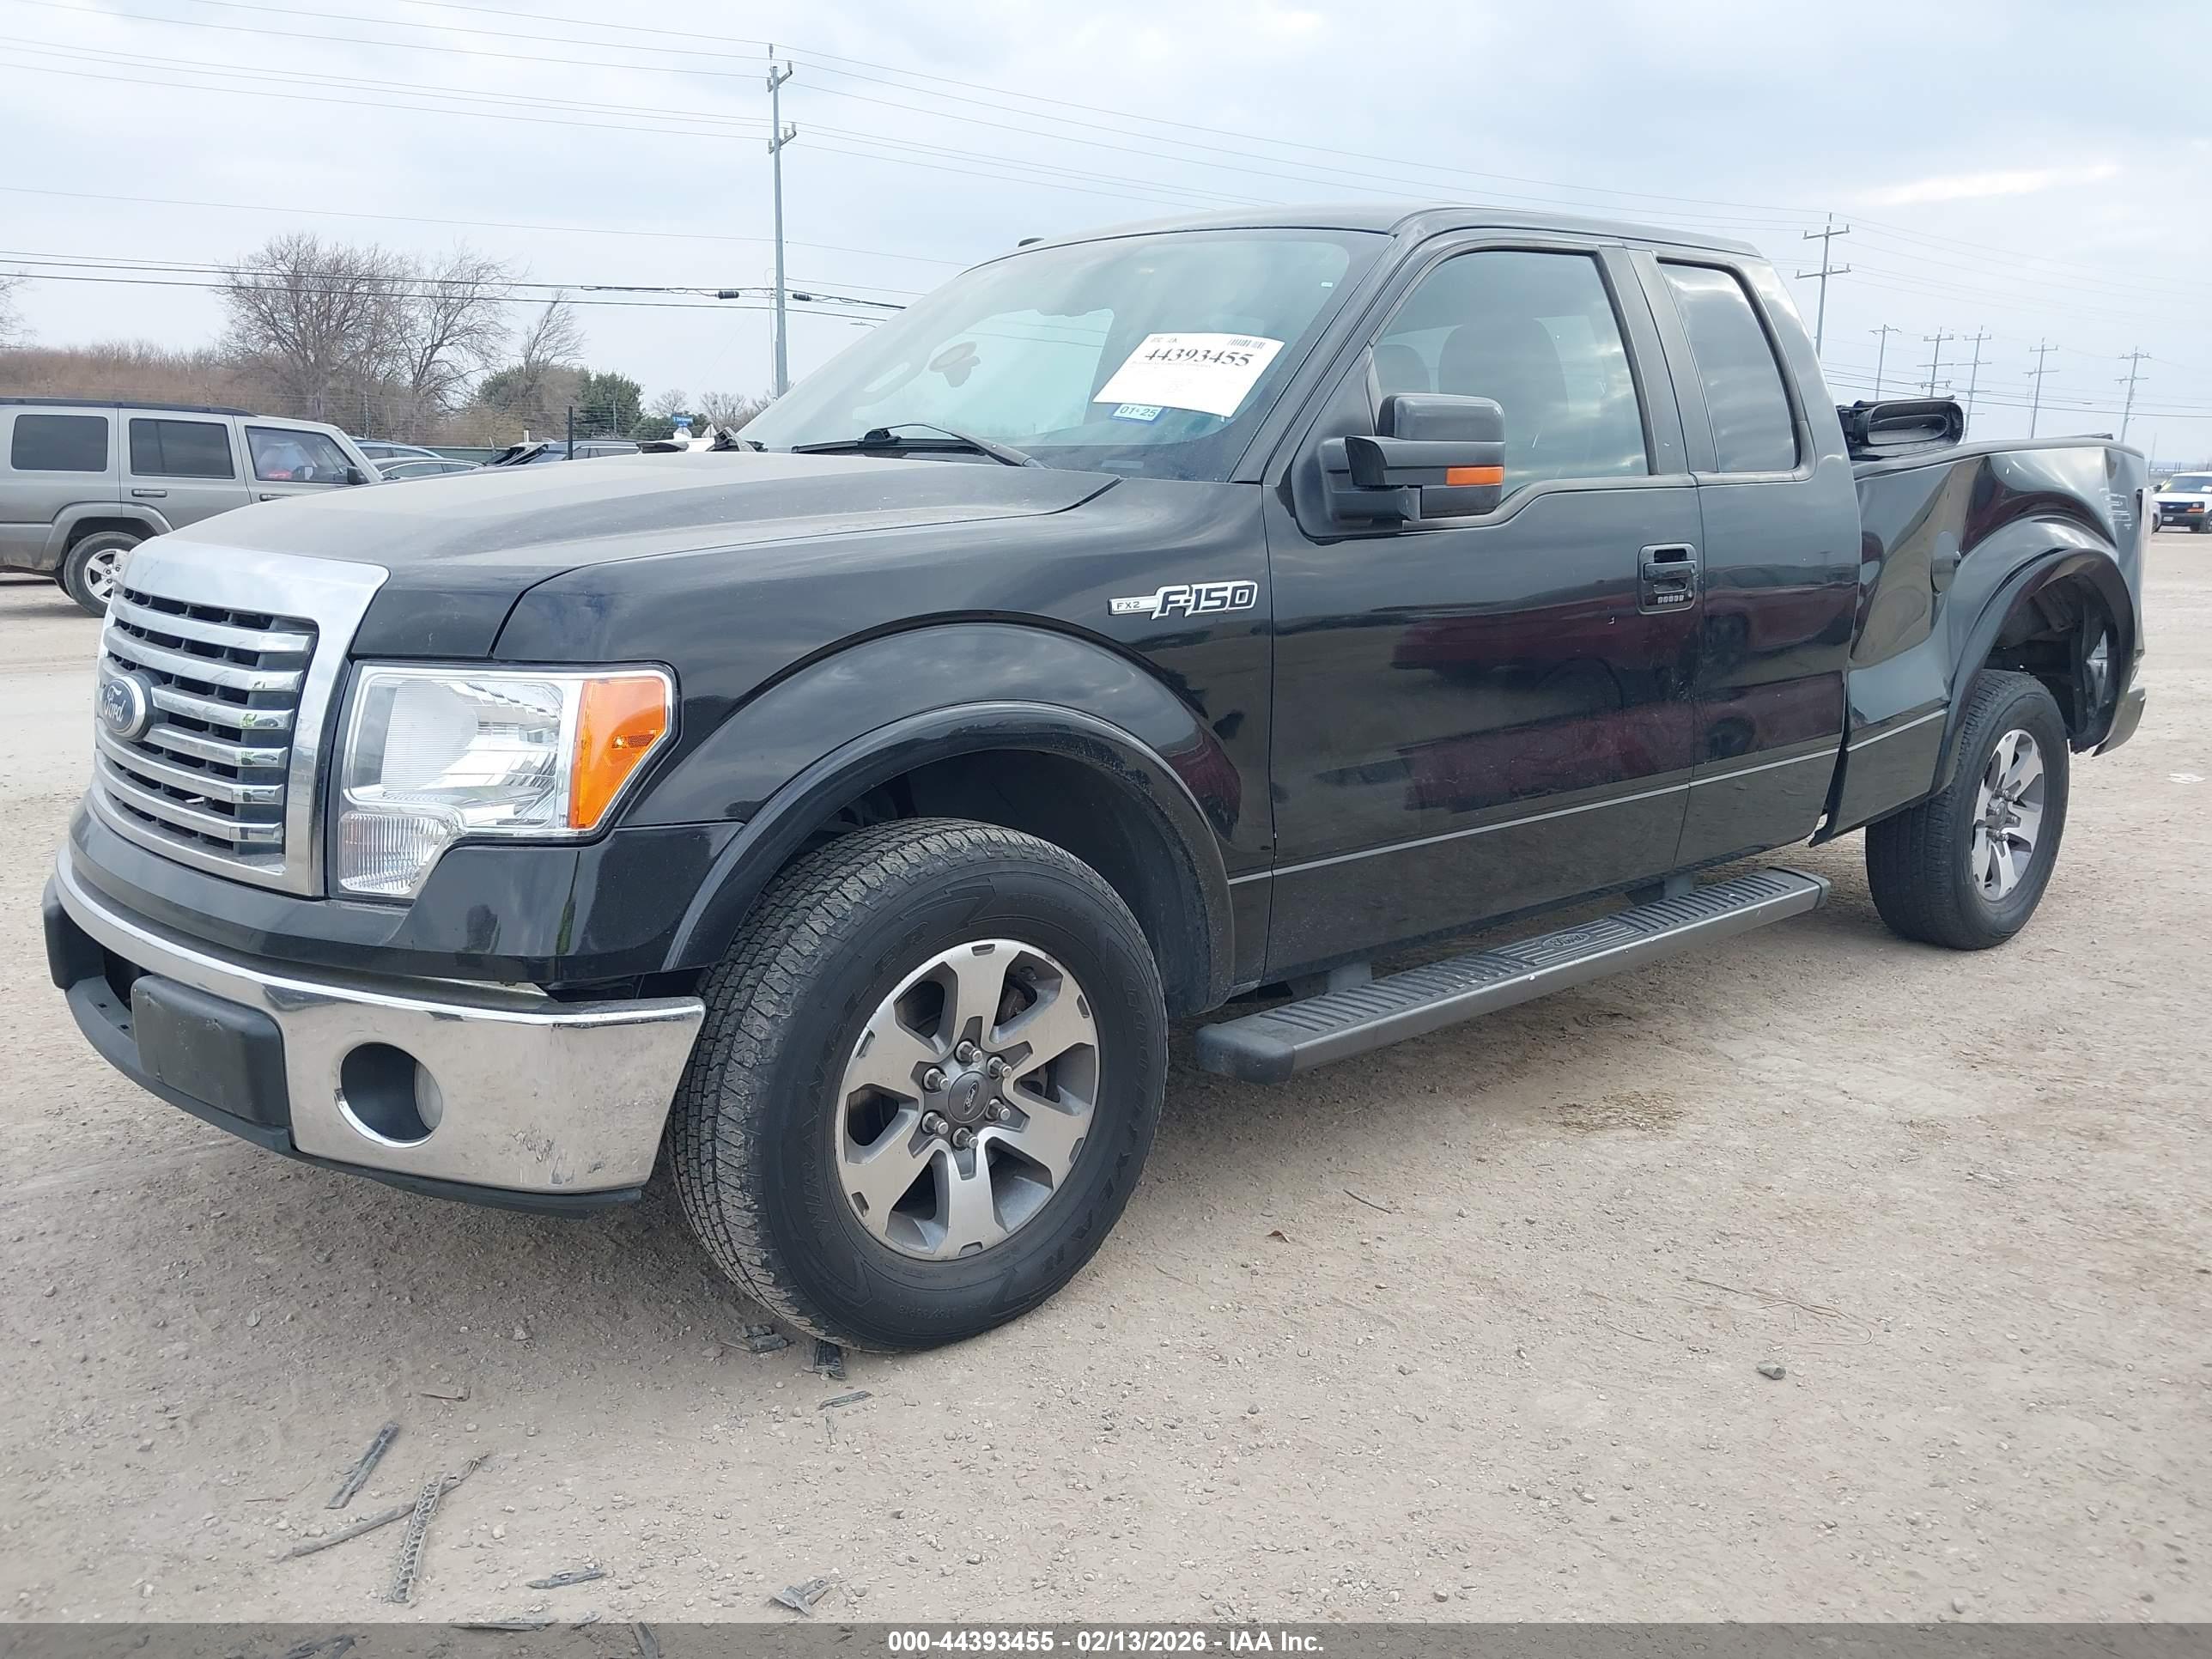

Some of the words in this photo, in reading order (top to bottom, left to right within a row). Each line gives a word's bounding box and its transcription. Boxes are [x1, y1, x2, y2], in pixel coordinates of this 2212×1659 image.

[1145, 348, 1255, 368] 44393455
[1116, 601, 1141, 610] FX2
[104, 685, 127, 722] Ford
